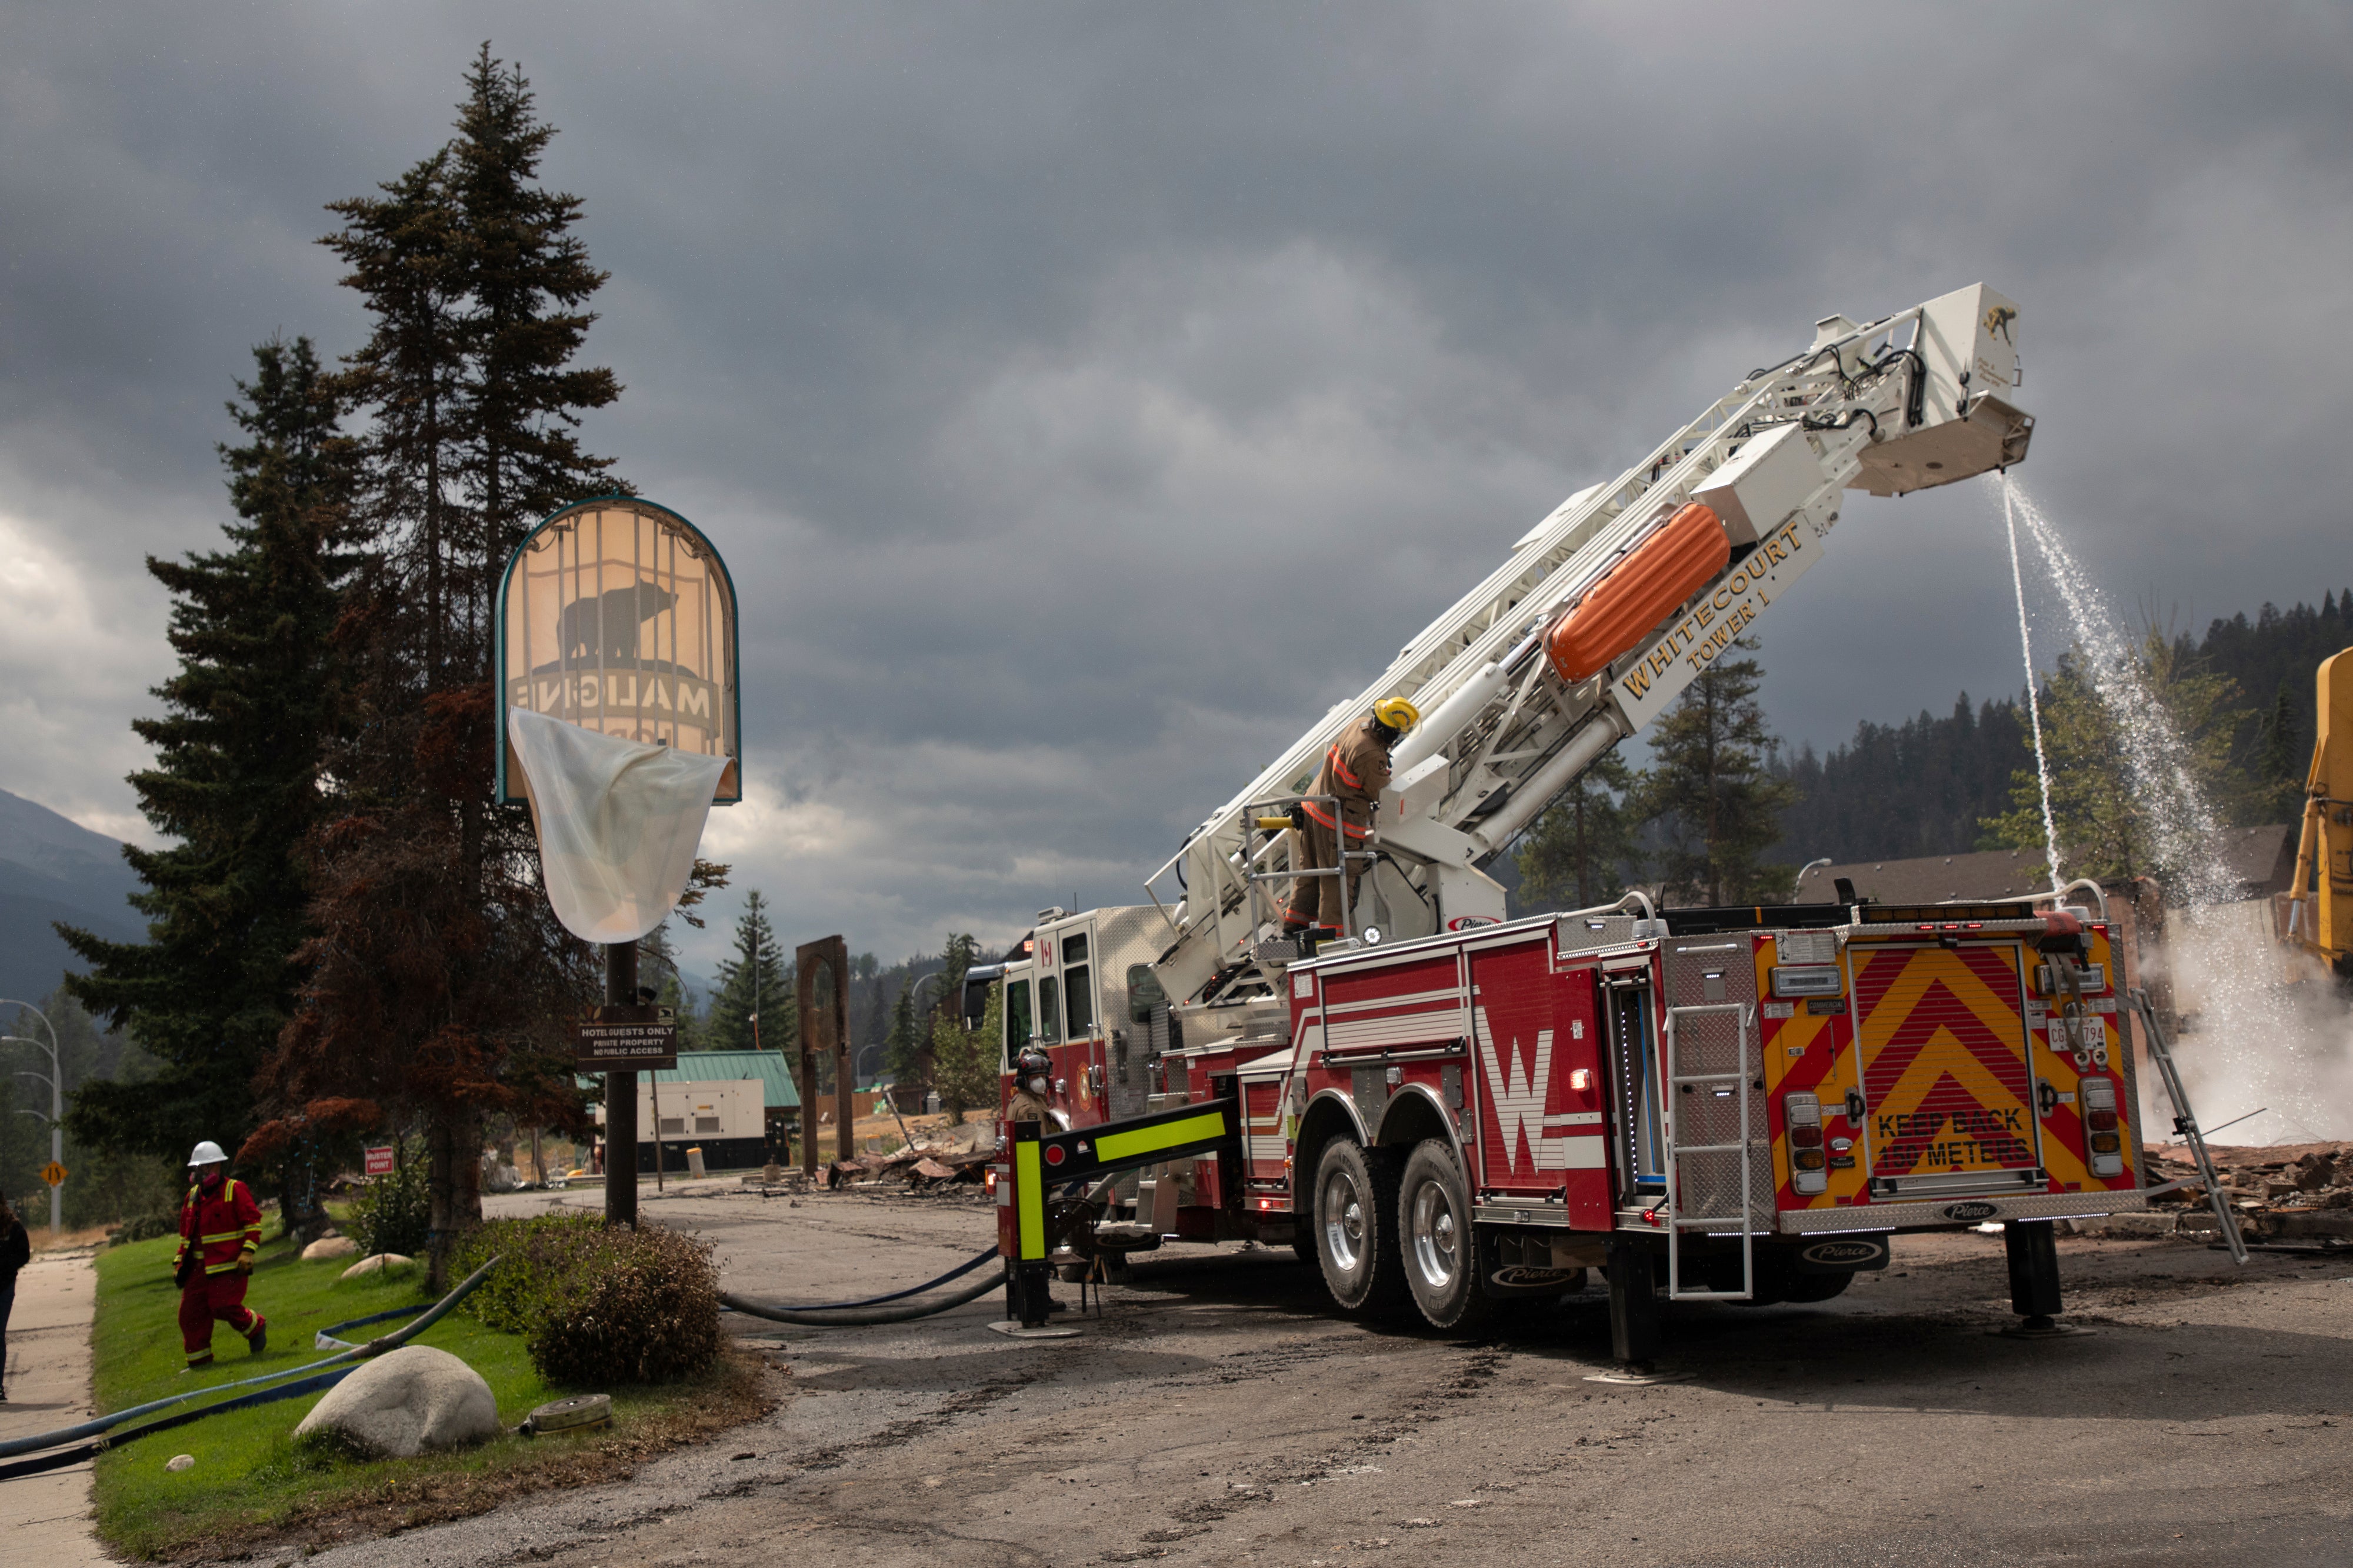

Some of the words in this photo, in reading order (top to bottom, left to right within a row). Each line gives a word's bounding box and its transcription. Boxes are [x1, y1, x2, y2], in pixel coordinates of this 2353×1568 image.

[1622, 522, 1801, 700] WHITECOURT
[1687, 603, 1756, 672] TOWER
[1758, 588, 1770, 607] 1
[609, 1028, 644, 1036] GUESTS
[1473, 1005, 1554, 1178] W
[1878, 1113, 1945, 1138] KEEP
[1952, 1108, 2022, 1134] BACK
[1878, 1145, 1919, 1168] 150
[1927, 1139, 2030, 1166] METERS
[370, 1161, 389, 1170] POINT
[1950, 1205, 1991, 1220] Pierce
[1819, 1246, 1867, 1259] Pierce
[1508, 1269, 1562, 1282] Pierce
